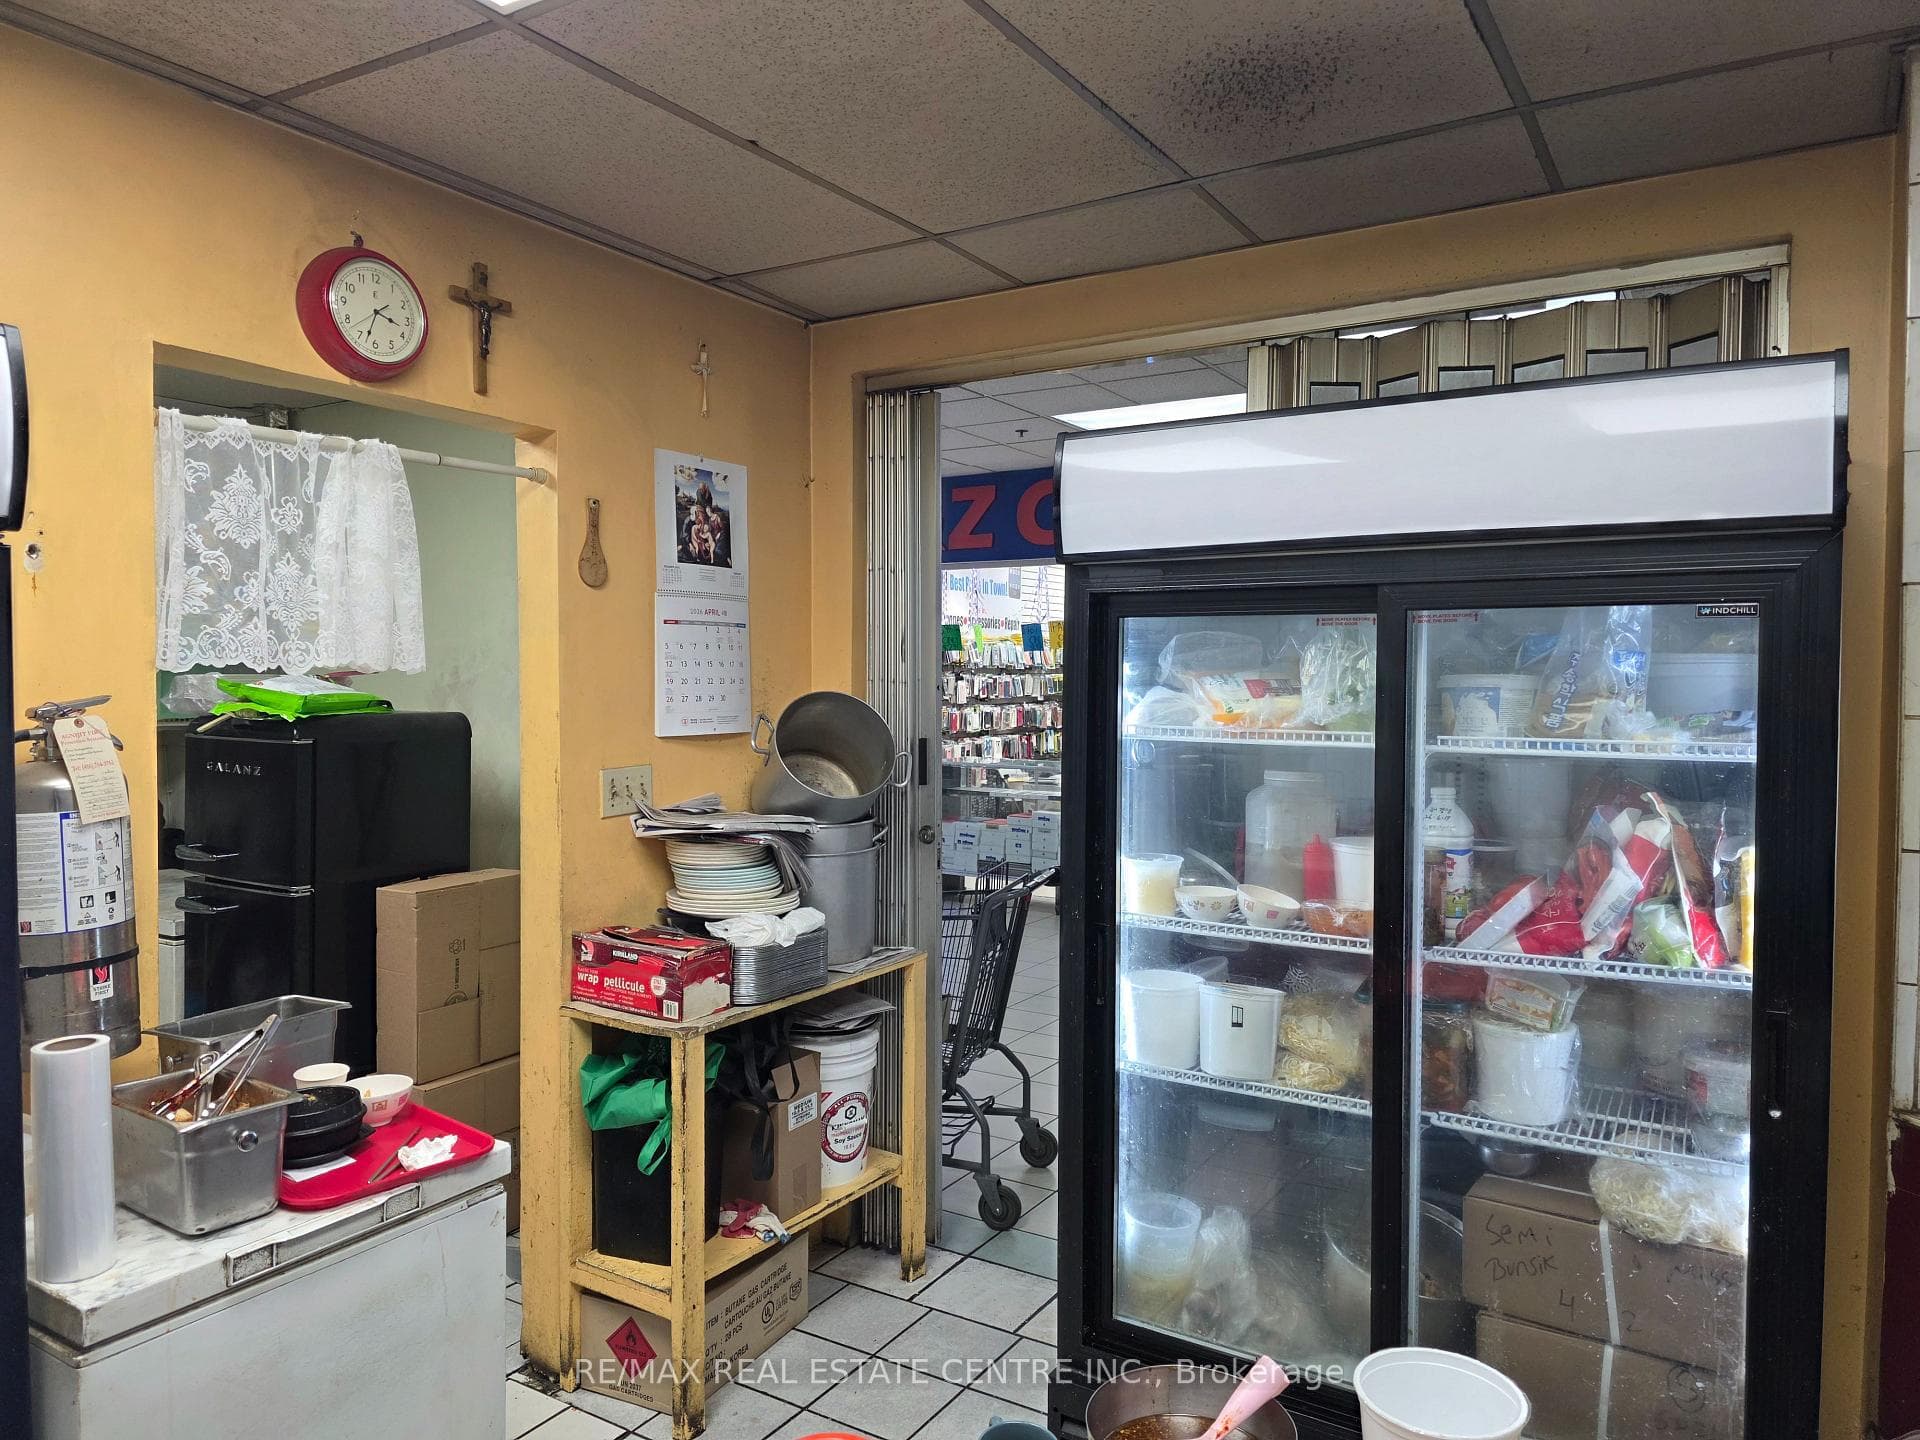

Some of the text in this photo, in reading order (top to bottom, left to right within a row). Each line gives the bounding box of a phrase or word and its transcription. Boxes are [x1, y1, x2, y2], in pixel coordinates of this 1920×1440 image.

[357, 272, 365, 286] 11
[371, 272, 381, 285] 12
[344, 281, 356, 294] 10
[340, 295, 347, 306] 9
[400, 300, 406, 310] 2
[344, 313, 351, 324] 8
[404, 317, 410, 327] 3
[356, 330, 363, 340] 7
[399, 331, 405, 341] 4
[372, 339, 379, 350] 6
[388, 340, 395, 350] 5
[704, 608, 721, 617] APRIL
[665, 660, 673, 668] 12
[680, 660, 688, 668] 13
[694, 660, 701, 668] 14
[707, 660, 713, 668] 15
[681, 677, 689, 685] 20
[694, 677, 701, 685] 21
[707, 677, 714, 685] 22
[666, 695, 674, 703] 26
[681, 695, 689, 703] 27
[695, 695, 703, 703] 28
[708, 694, 715, 702] 29
[206, 761, 262, 776] GALANZ
[612, 949, 639, 962] KIRKLAND
[577, 972, 599, 985] wrap
[603, 976, 646, 993] pellicule
[834, 1132, 863, 1145] Soy Sauce
[705, 1313, 719, 1331] ITEM
[724, 1293, 747, 1317] BUTANE
[747, 1284, 760, 1299] GAS
[760, 1262, 788, 1289] CARTRIDGE
[1559, 1288, 1576, 1322] 4
[724, 1300, 756, 1329] CARTOUCHE
[732, 1322, 743, 1336] PCS
[729, 1343, 749, 1362] KOREA
